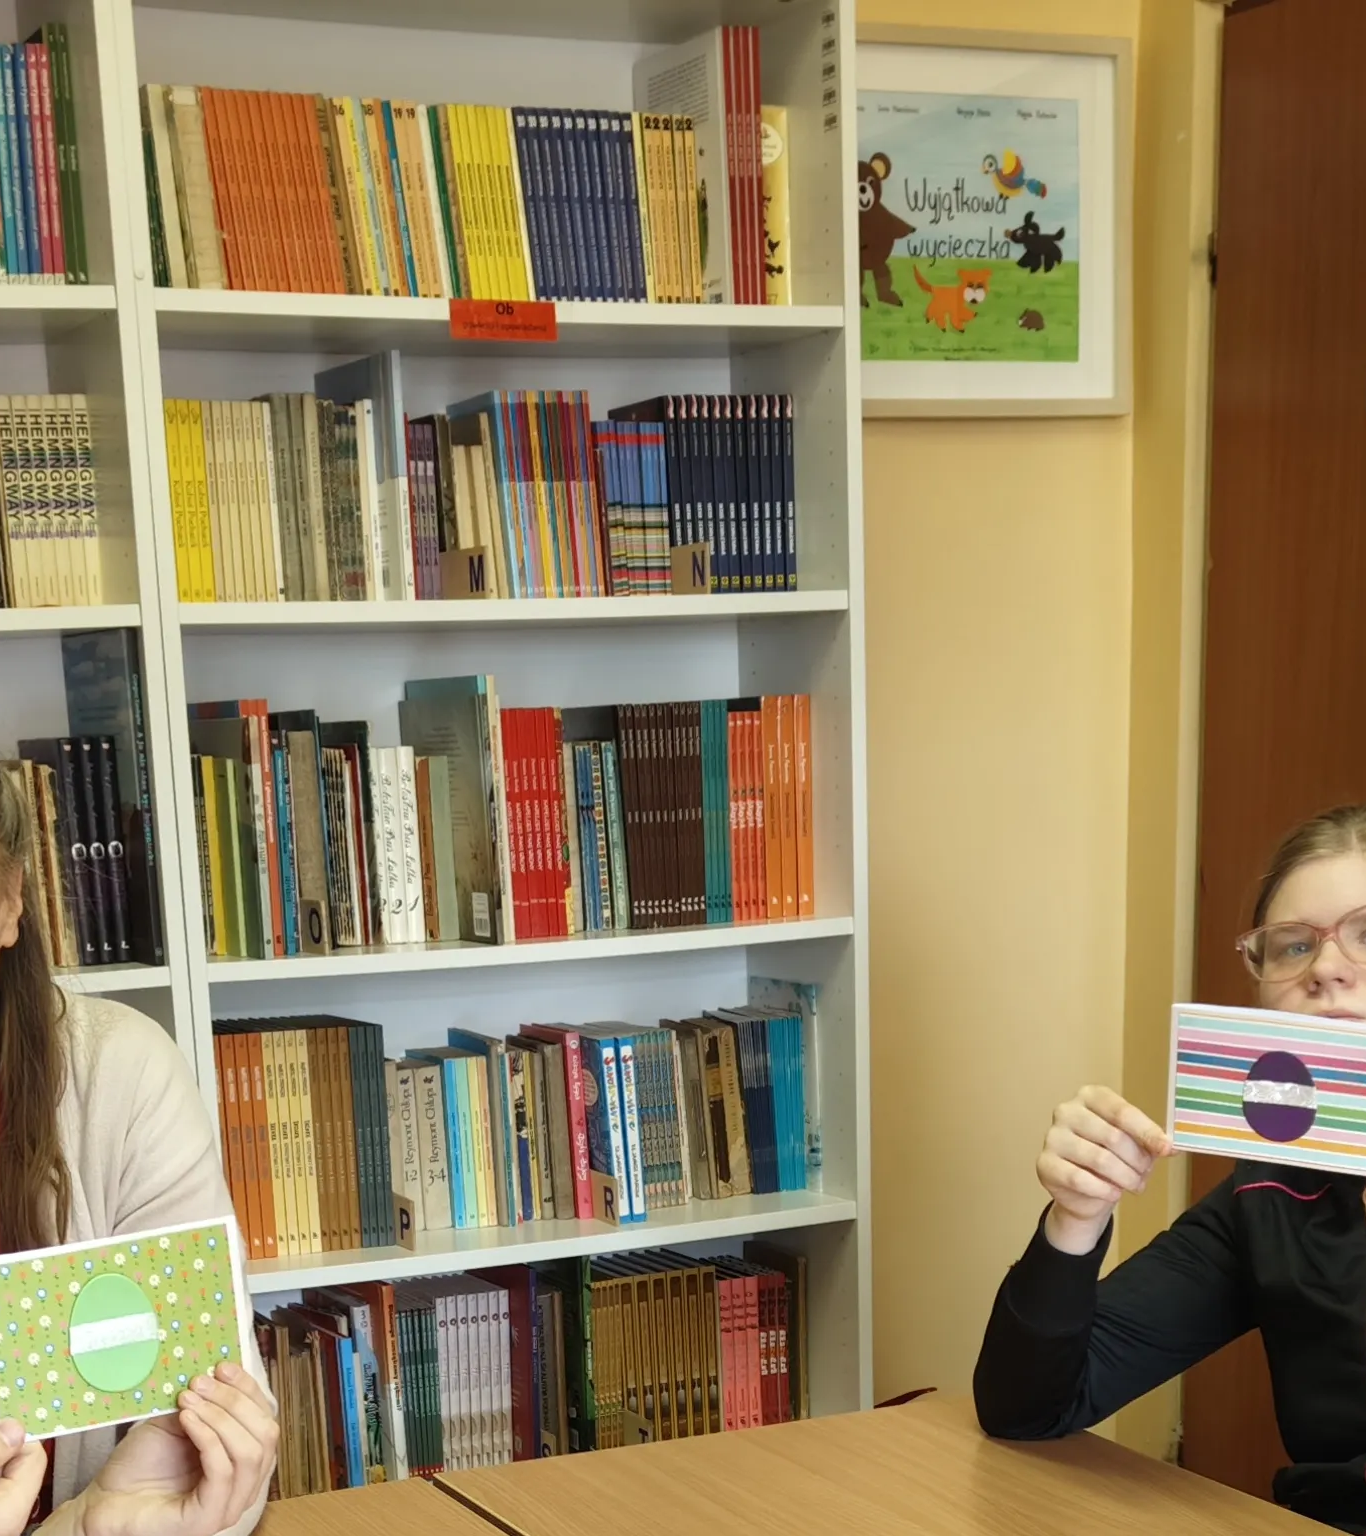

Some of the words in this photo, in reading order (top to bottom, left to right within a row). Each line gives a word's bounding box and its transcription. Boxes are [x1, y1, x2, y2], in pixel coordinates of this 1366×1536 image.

[904, 177, 1009, 225] Wyjątkowa
[907, 226, 1011, 268] wycieczka
[495, 303, 514, 317] Ob
[0, 413, 23, 522] HEMINGWAY
[14, 414, 38, 522] HEMINGWAY
[29, 414, 52, 522] HEMINGWAY
[44, 414, 67, 521] HEMINGWAY
[59, 414, 81, 520] HEMINGWAY
[74, 413, 96, 520] HEMINGWAY
[468, 555, 485, 593] M
[691, 551, 705, 587] N
[403, 1123, 415, 1165] Reymont
[428, 1121, 440, 1163] Reymont
[602, 1185, 616, 1217] R
[399, 1207, 411, 1240] P
